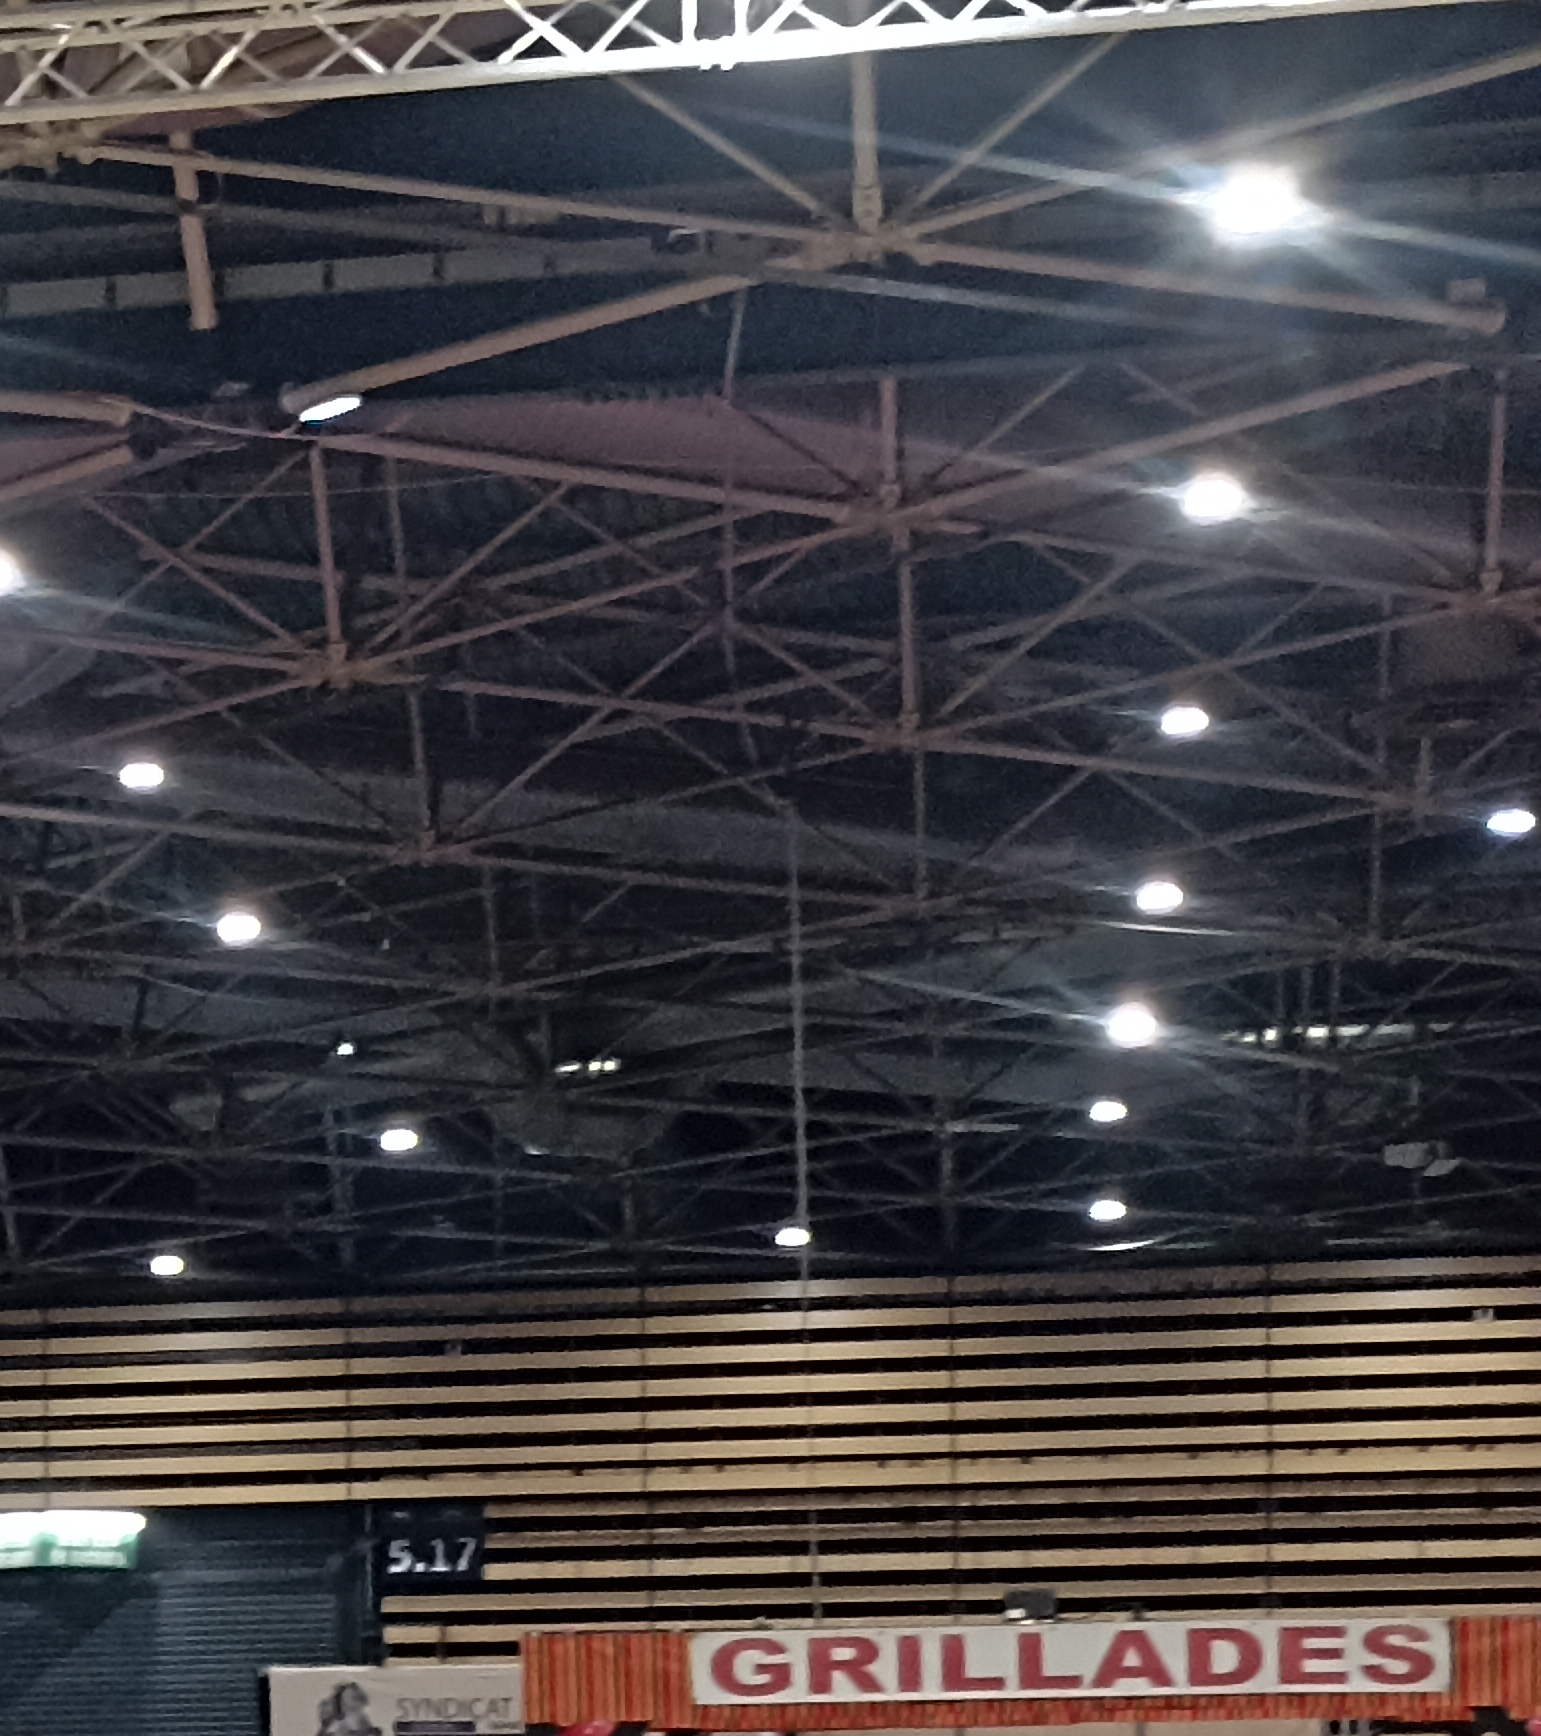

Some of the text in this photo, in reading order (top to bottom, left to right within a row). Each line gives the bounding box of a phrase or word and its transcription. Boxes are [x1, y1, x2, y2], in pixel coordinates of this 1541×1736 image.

[387, 1537, 477, 1574] 5.17
[708, 1624, 1436, 1698] GRILLADES
[396, 1696, 513, 1720] SYNDICAT
